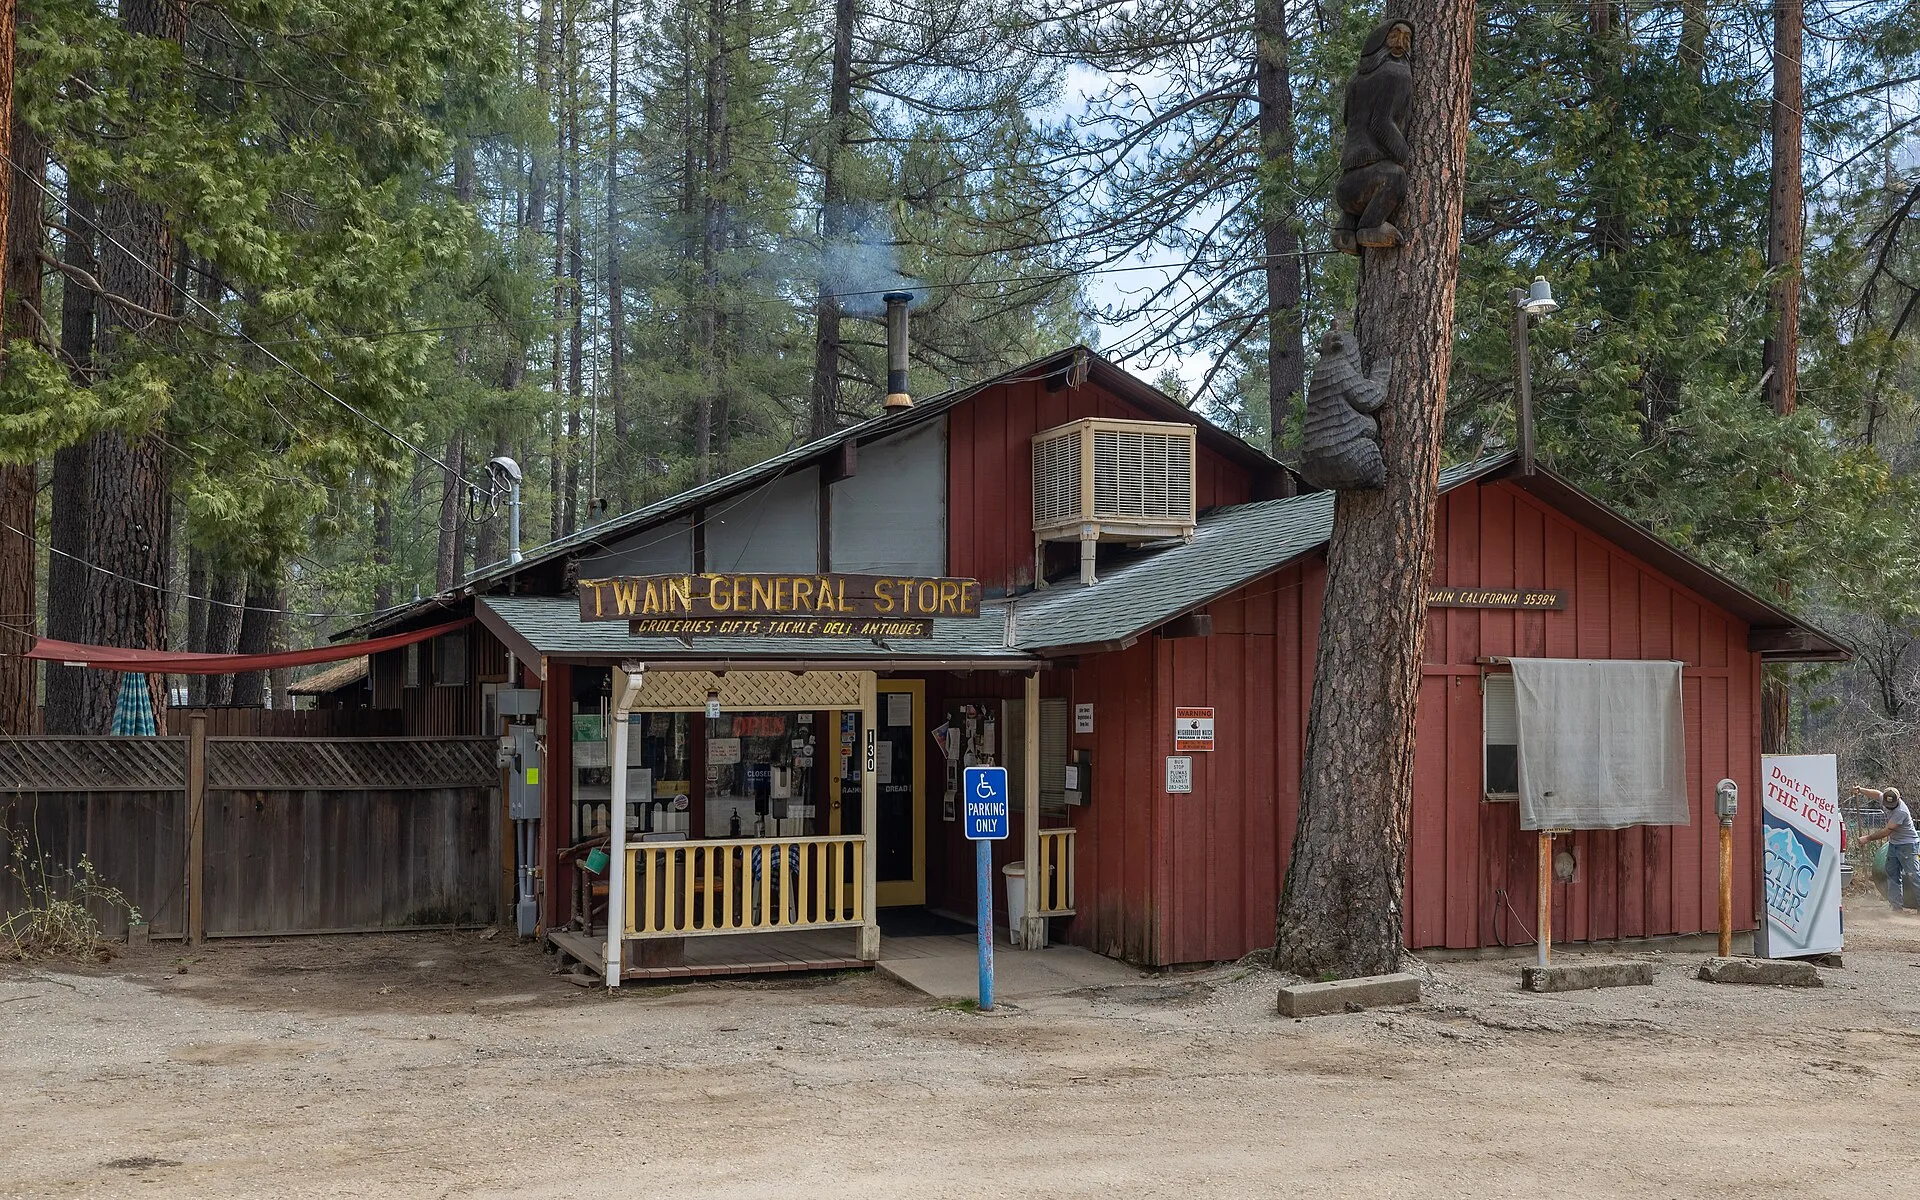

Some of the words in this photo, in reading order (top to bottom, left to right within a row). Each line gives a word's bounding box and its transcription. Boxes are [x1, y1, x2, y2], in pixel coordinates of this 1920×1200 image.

[579, 577, 693, 618] TWAIN
[709, 576, 856, 613] GENERAL
[873, 580, 976, 614] STORE
[1427, 591, 1455, 602] WAIN
[1459, 591, 1519, 604] CALIFORNIA
[1523, 593, 1557, 606] 95984
[638, 619, 713, 633] GROCERIES
[718, 619, 759, 634] GIFTS
[767, 620, 821, 635] TACKLE
[860, 622, 924, 636] ANTIQUES
[733, 716, 785, 737] OPEN
[747, 770, 772, 778] CLOSED
[1771, 766, 1801, 793] Don't
[1801, 784, 1835, 814] Forget
[968, 802, 1005, 817] PARKING
[1767, 782, 1799, 812] THE
[1801, 803, 1832, 833] ICE!
[976, 818, 998, 833] ONLY
